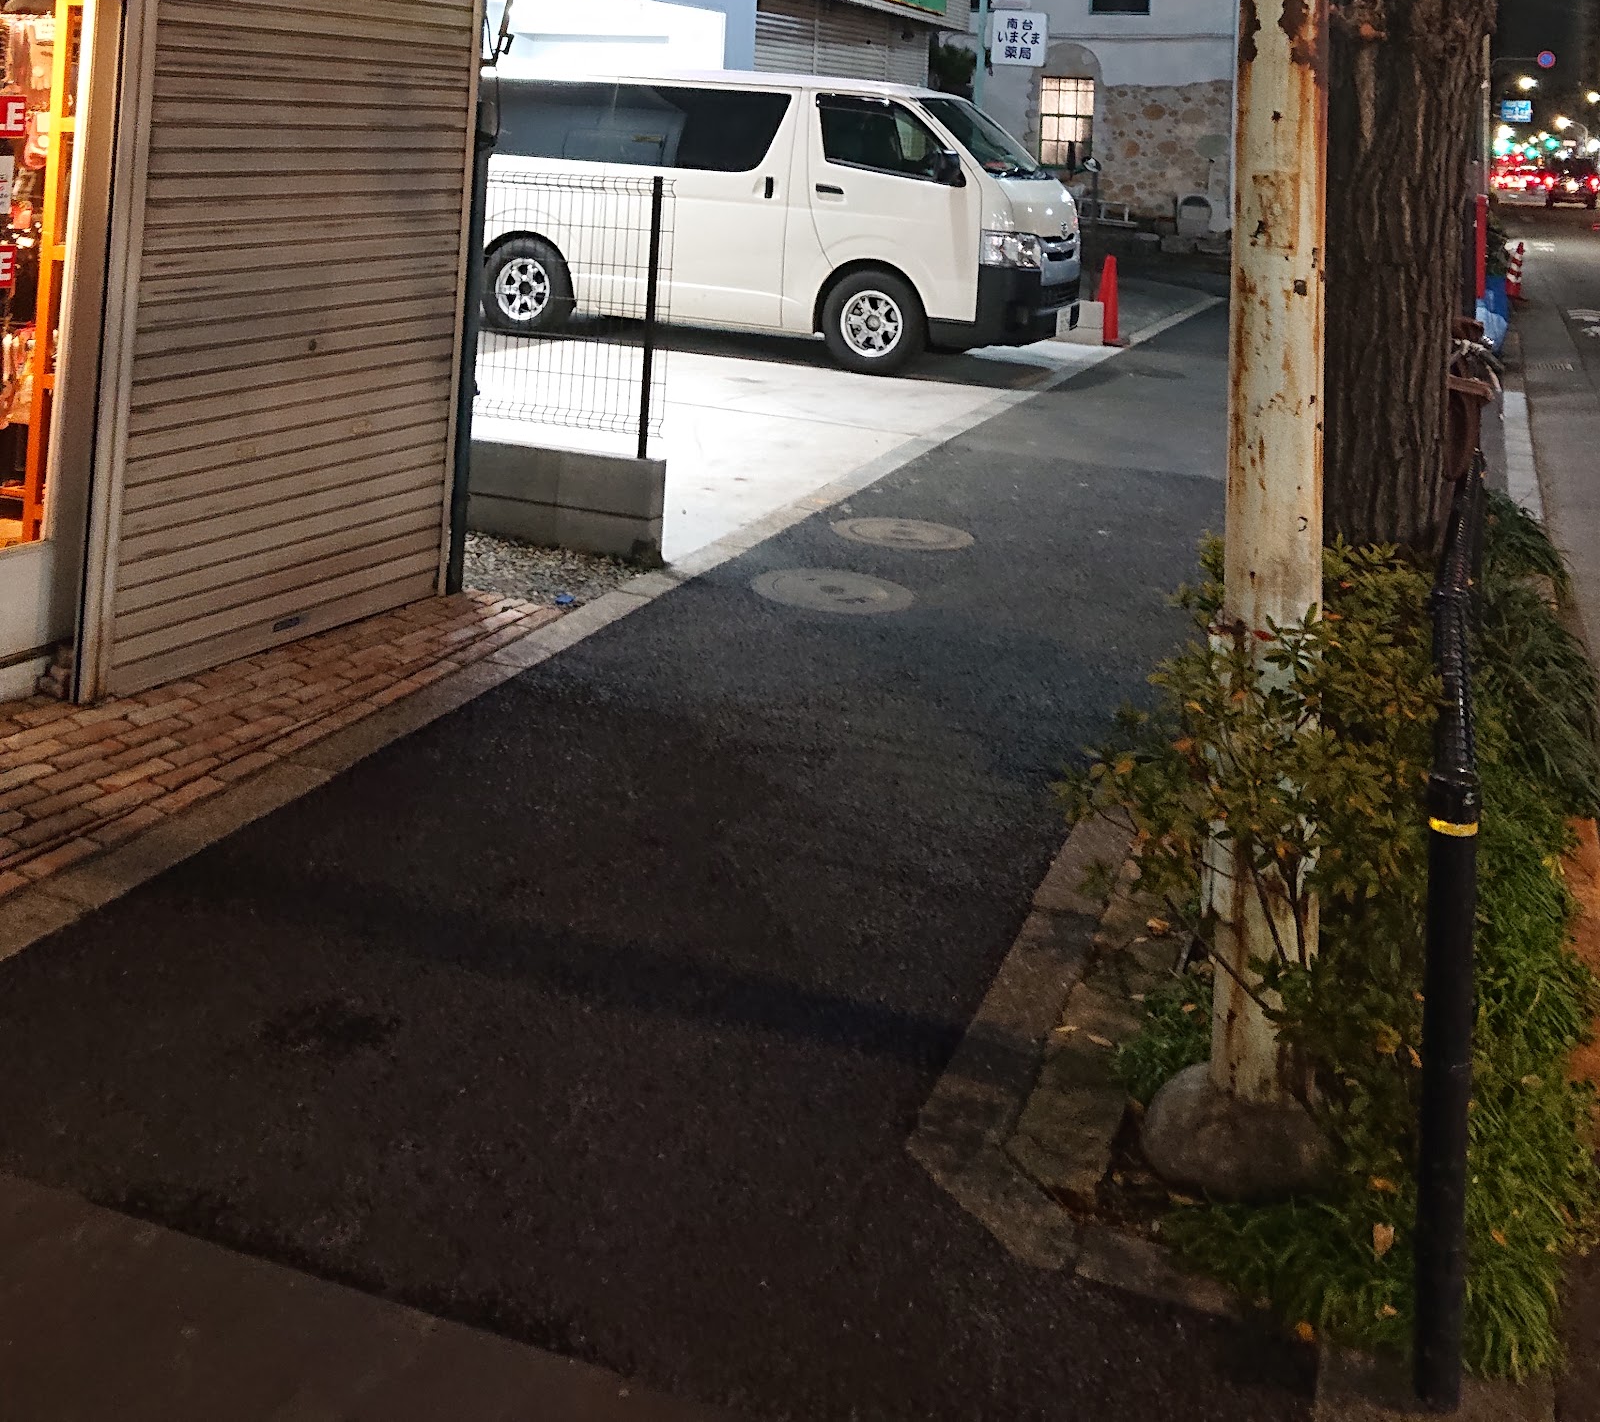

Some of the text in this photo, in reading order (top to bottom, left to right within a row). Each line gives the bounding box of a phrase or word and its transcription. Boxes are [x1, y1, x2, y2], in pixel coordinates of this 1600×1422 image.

[1006, 18, 1034, 31] 南台
[997, 31, 1041, 45] いまくま
[1004, 45, 1032, 60] 薬局
